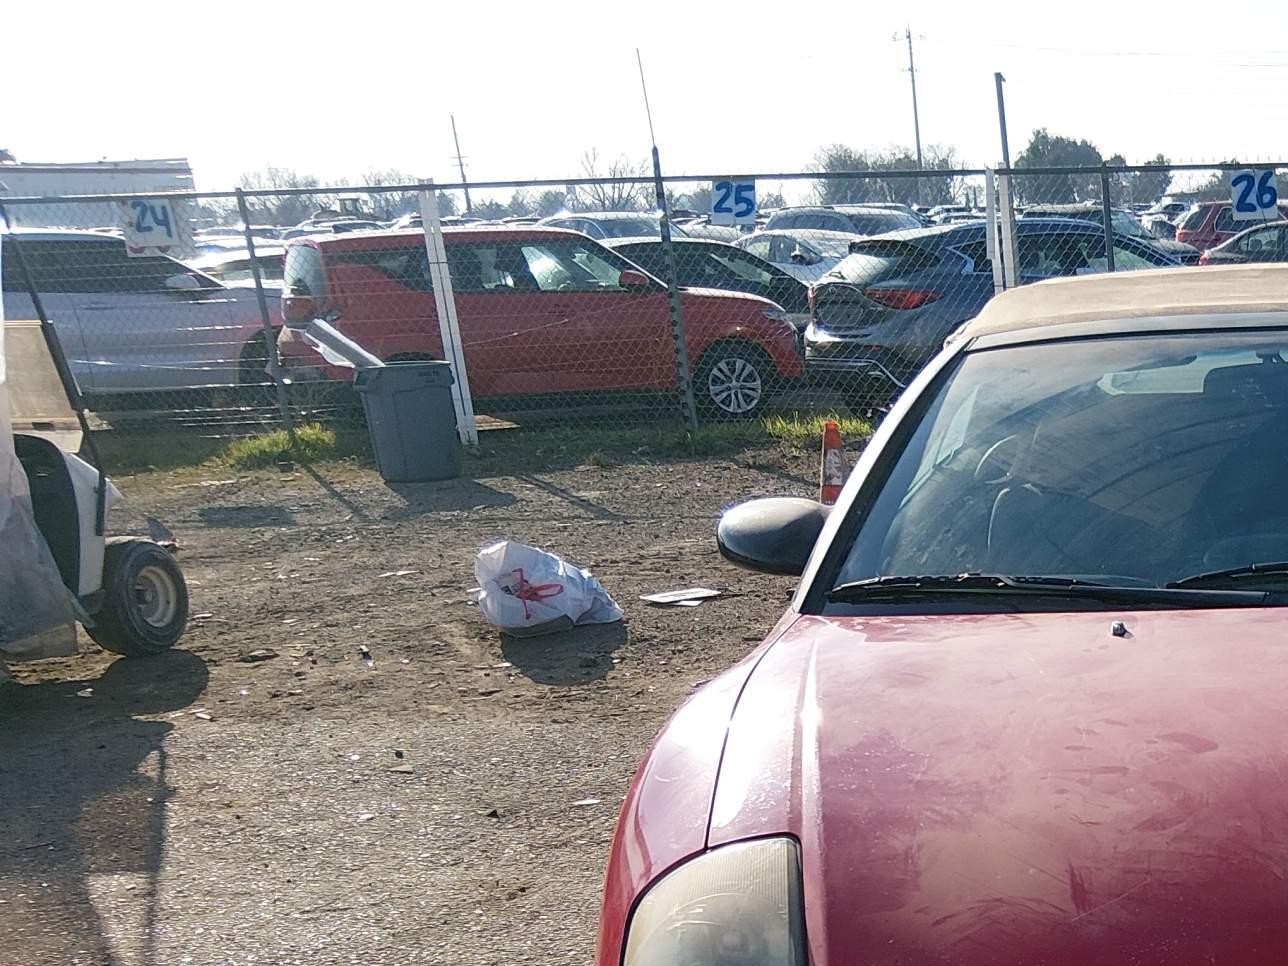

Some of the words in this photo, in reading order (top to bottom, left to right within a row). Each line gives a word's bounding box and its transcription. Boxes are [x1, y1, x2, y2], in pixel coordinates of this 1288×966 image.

[712, 181, 755, 218] 25
[1231, 170, 1278, 213] 26
[130, 199, 173, 238] 24
